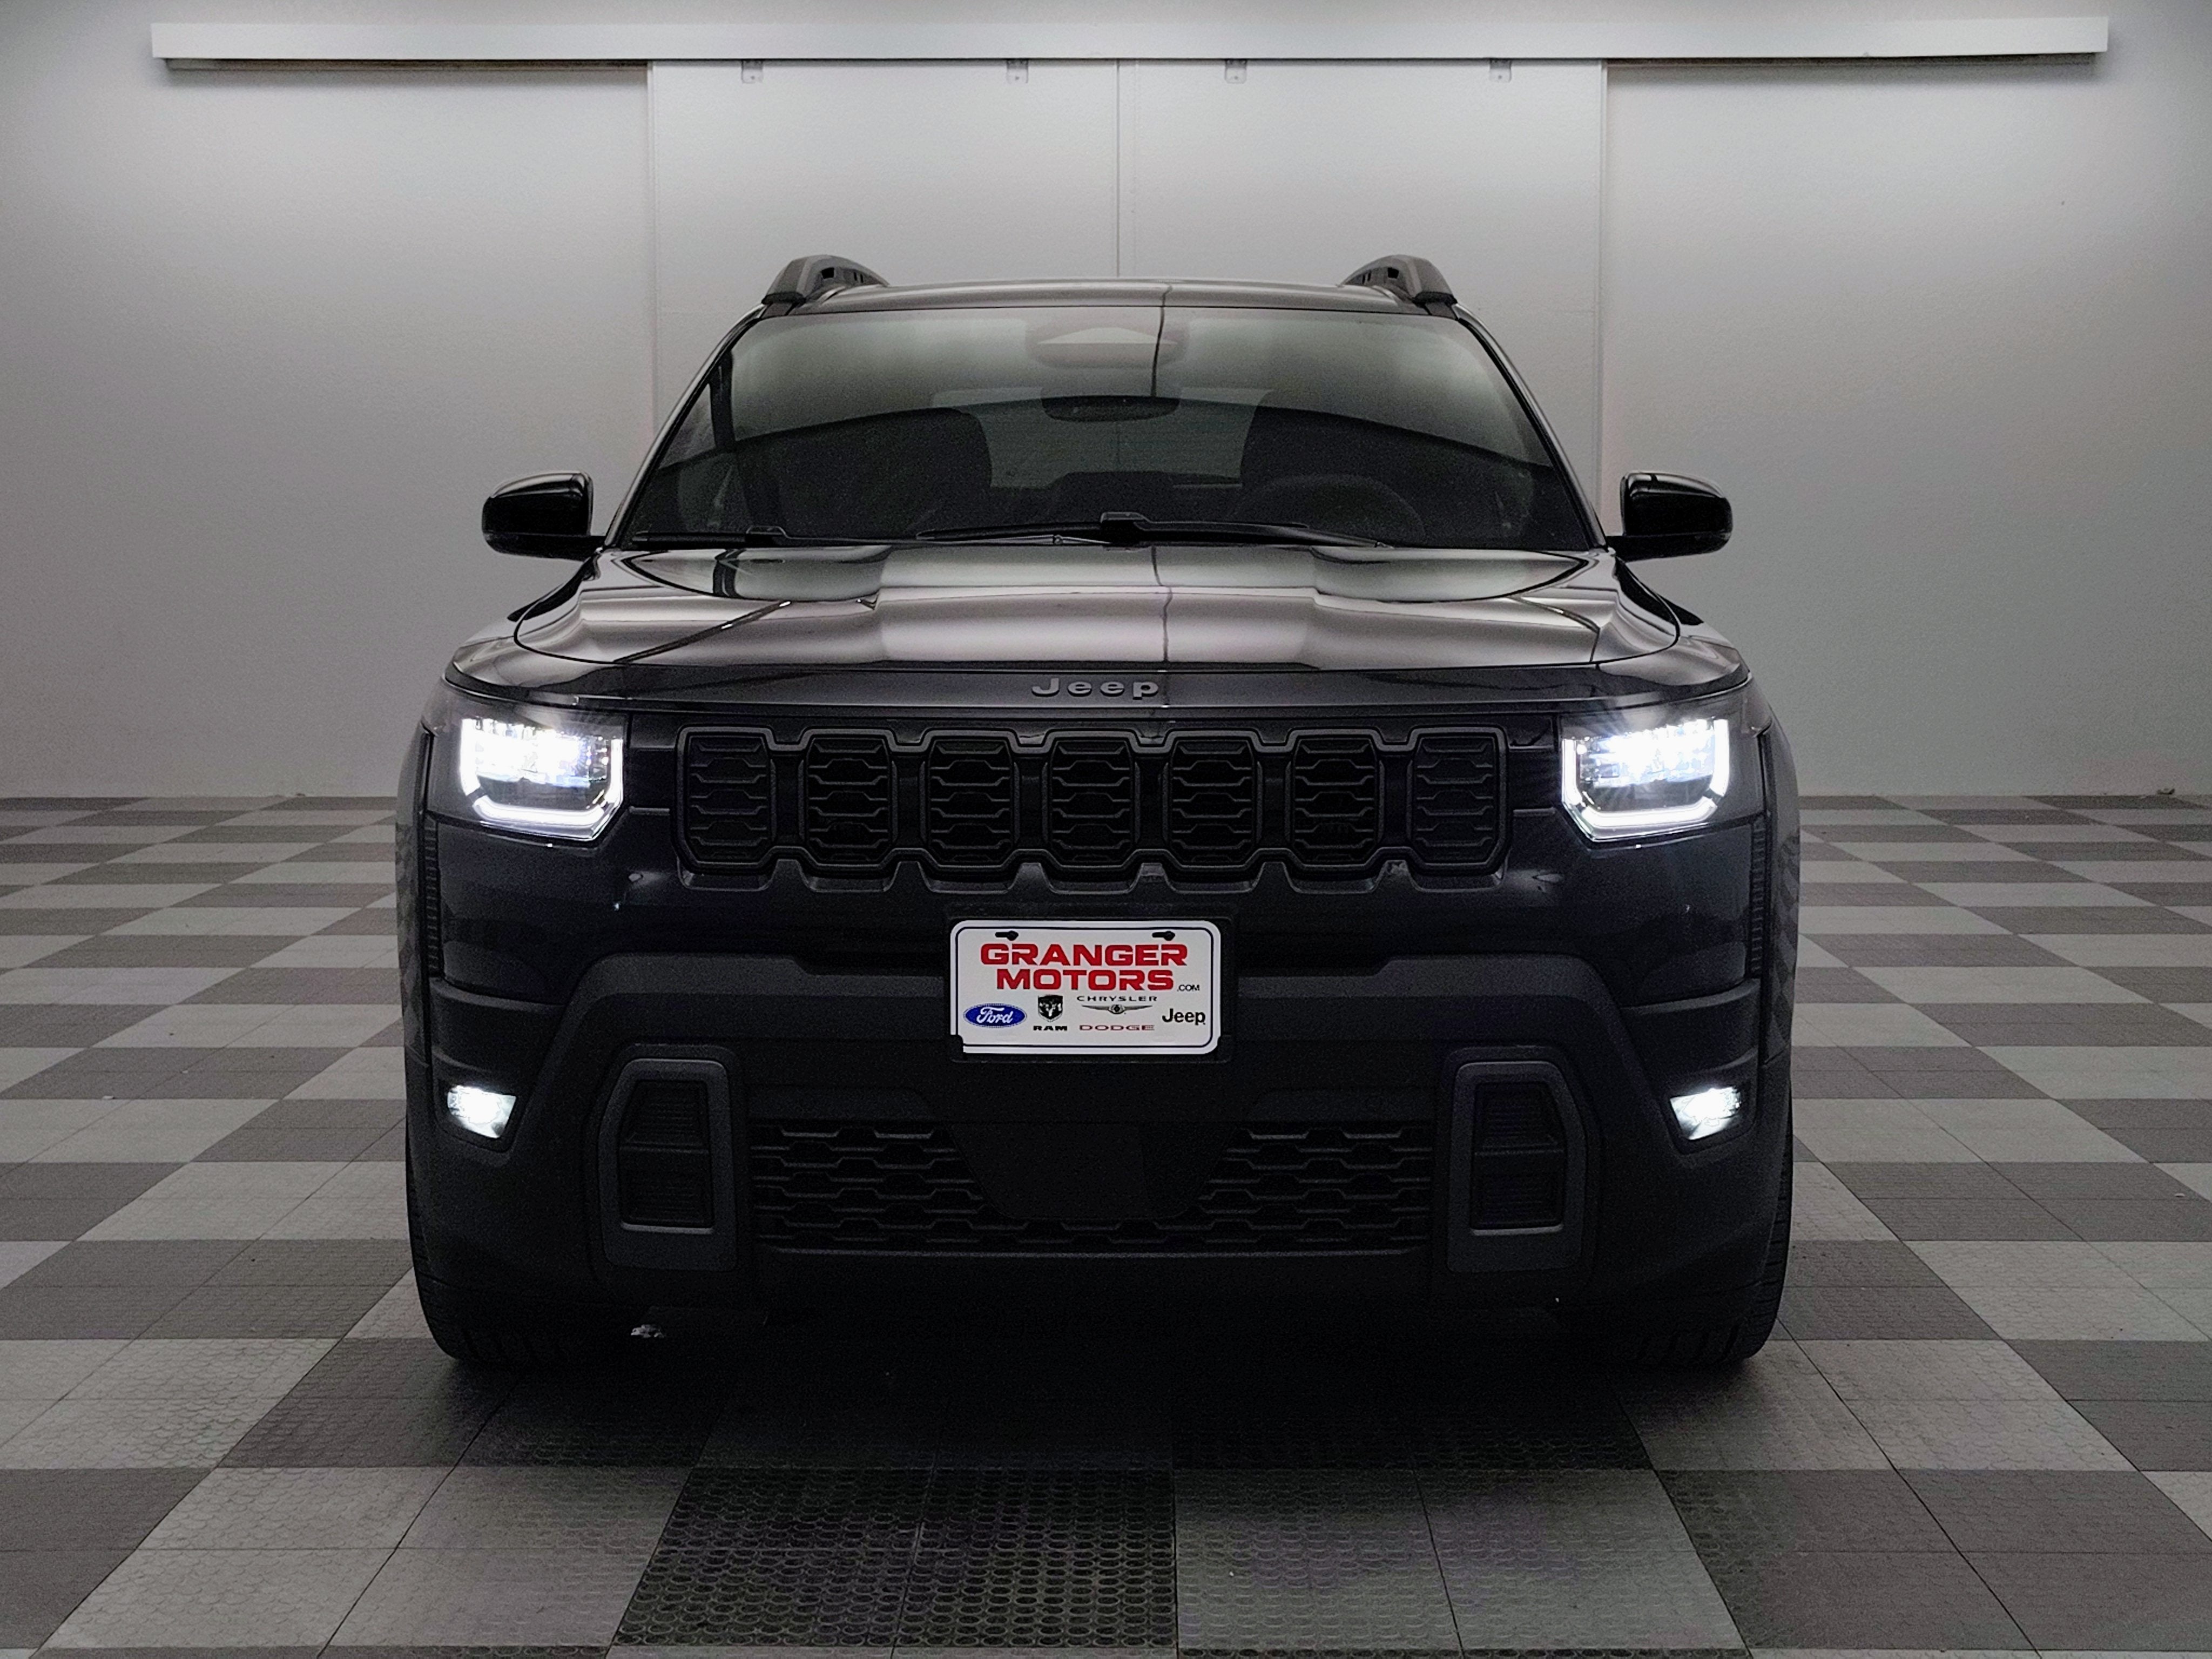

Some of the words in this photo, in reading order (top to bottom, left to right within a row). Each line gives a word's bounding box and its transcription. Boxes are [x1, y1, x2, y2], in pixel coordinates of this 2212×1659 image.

[1031, 678, 1158, 700] Jeep
[980, 943, 1188, 966] GRANGER
[996, 969, 1174, 990] MOTORS
[976, 1006, 1014, 1024] Ford
[1162, 1008, 1205, 1025] Jeep
